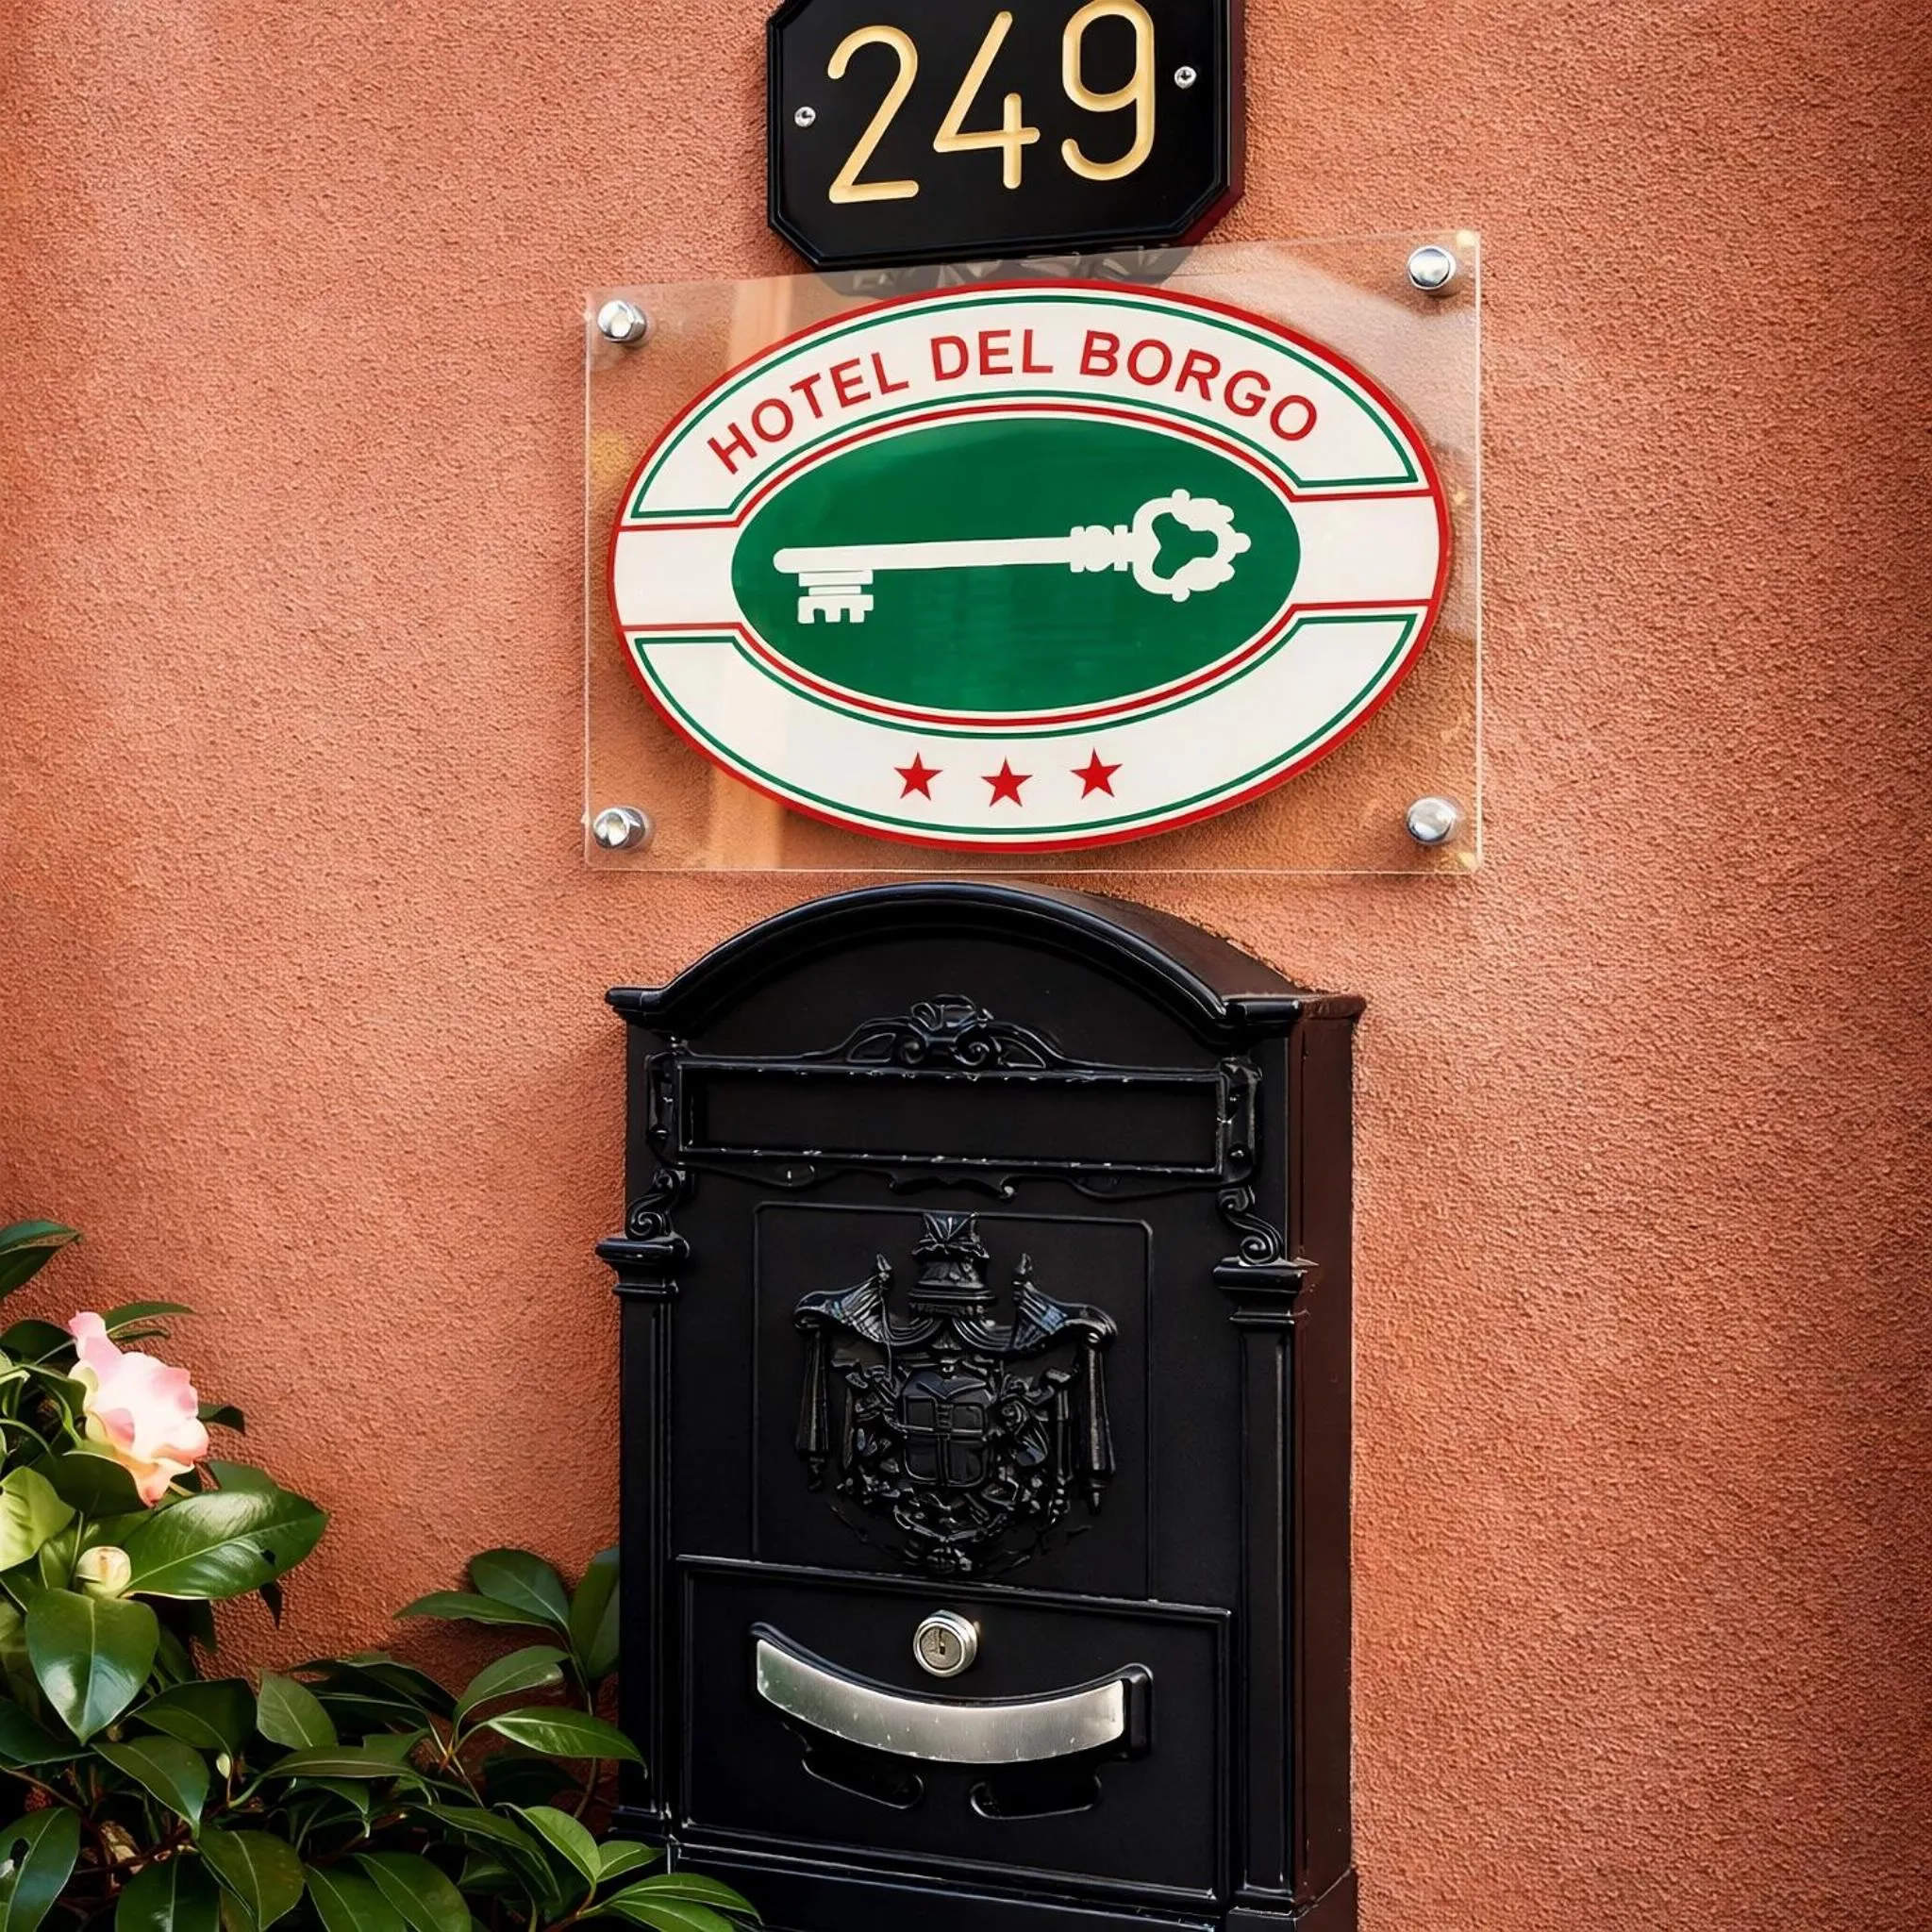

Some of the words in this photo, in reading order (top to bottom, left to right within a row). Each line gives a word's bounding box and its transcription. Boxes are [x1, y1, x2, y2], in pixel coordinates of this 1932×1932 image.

[827, 0, 1156, 204] 249
[707, 353, 909, 475] HOTEL
[930, 328, 1055, 381] DEL
[1079, 329, 1319, 442] BORGO
